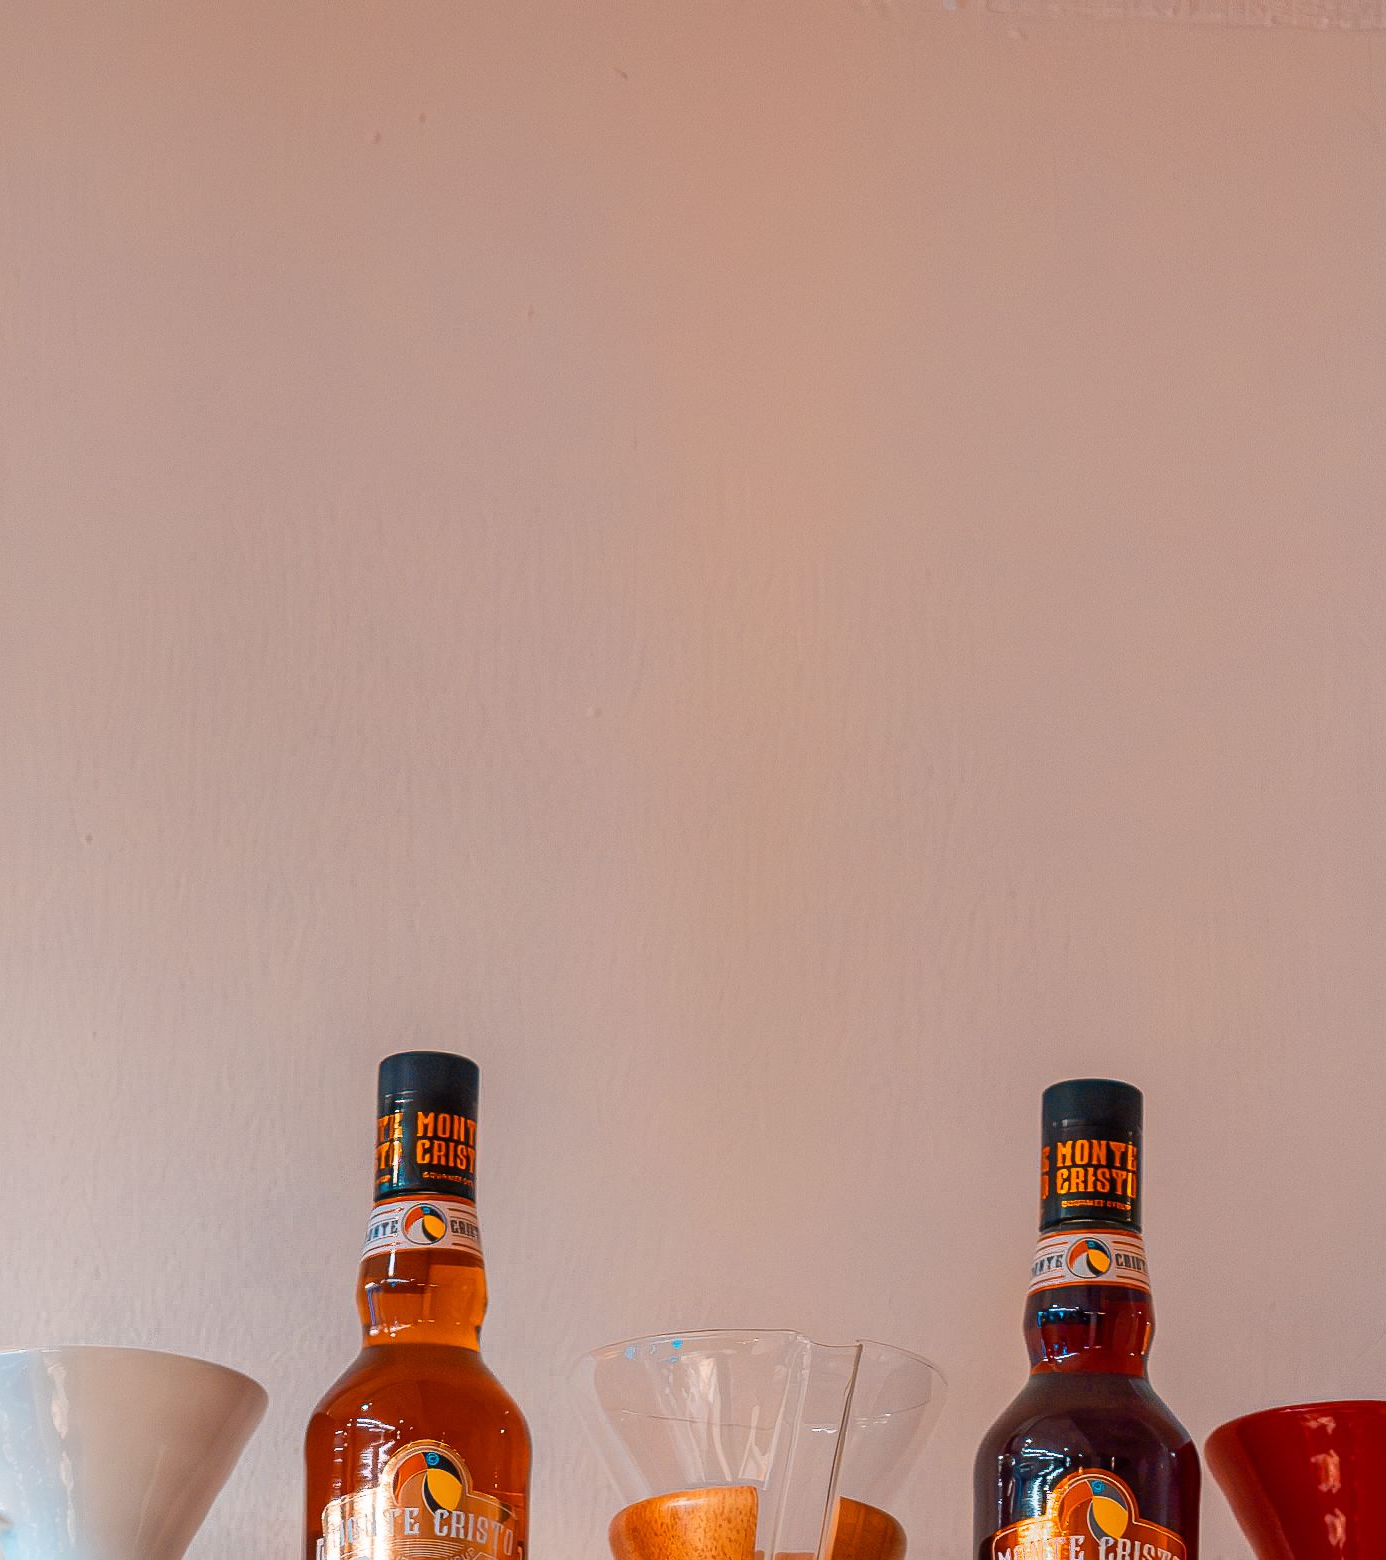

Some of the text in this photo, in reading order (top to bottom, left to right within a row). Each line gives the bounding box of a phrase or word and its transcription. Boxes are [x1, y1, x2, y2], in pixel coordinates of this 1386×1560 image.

[416, 1111, 478, 1145] MONT
[415, 1139, 477, 1174] CRIST
[1056, 1139, 1138, 1172] MONTE
[1056, 1167, 1138, 1200] CRISTO
[434, 1508, 514, 1557] CRISTO
